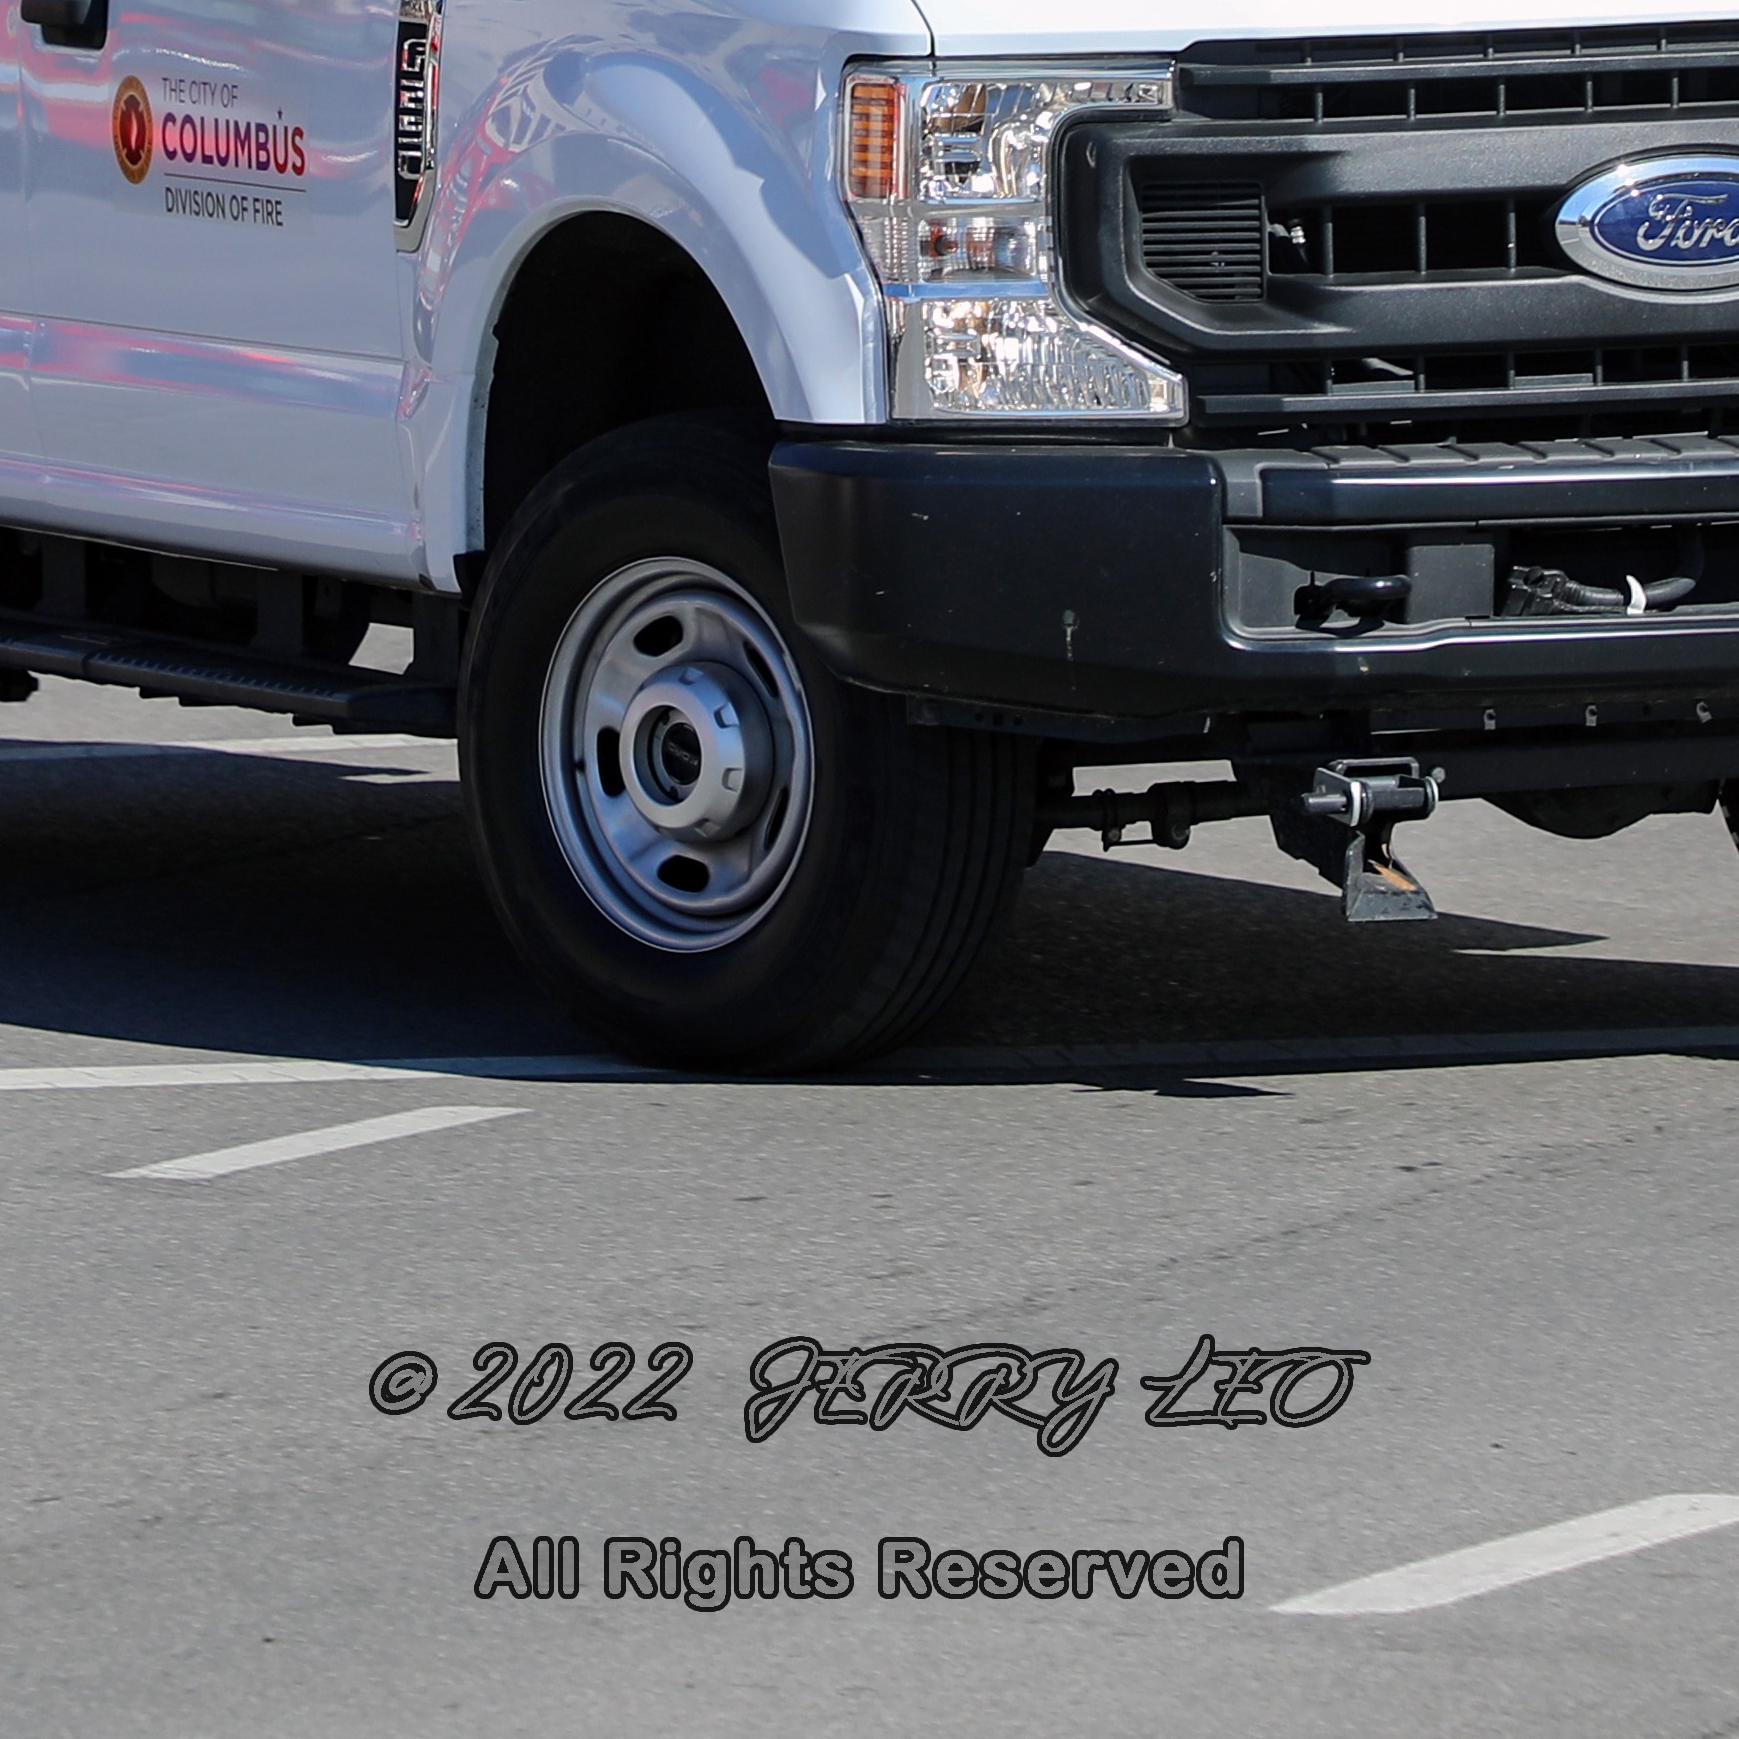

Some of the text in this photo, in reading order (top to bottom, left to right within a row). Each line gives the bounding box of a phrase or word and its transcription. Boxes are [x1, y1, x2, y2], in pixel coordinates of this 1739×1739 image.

[162, 77, 239, 109] THE CITY OF
[162, 112, 306, 177] COLUMBUS
[164, 186, 284, 228] DIVISION OF FIRE
